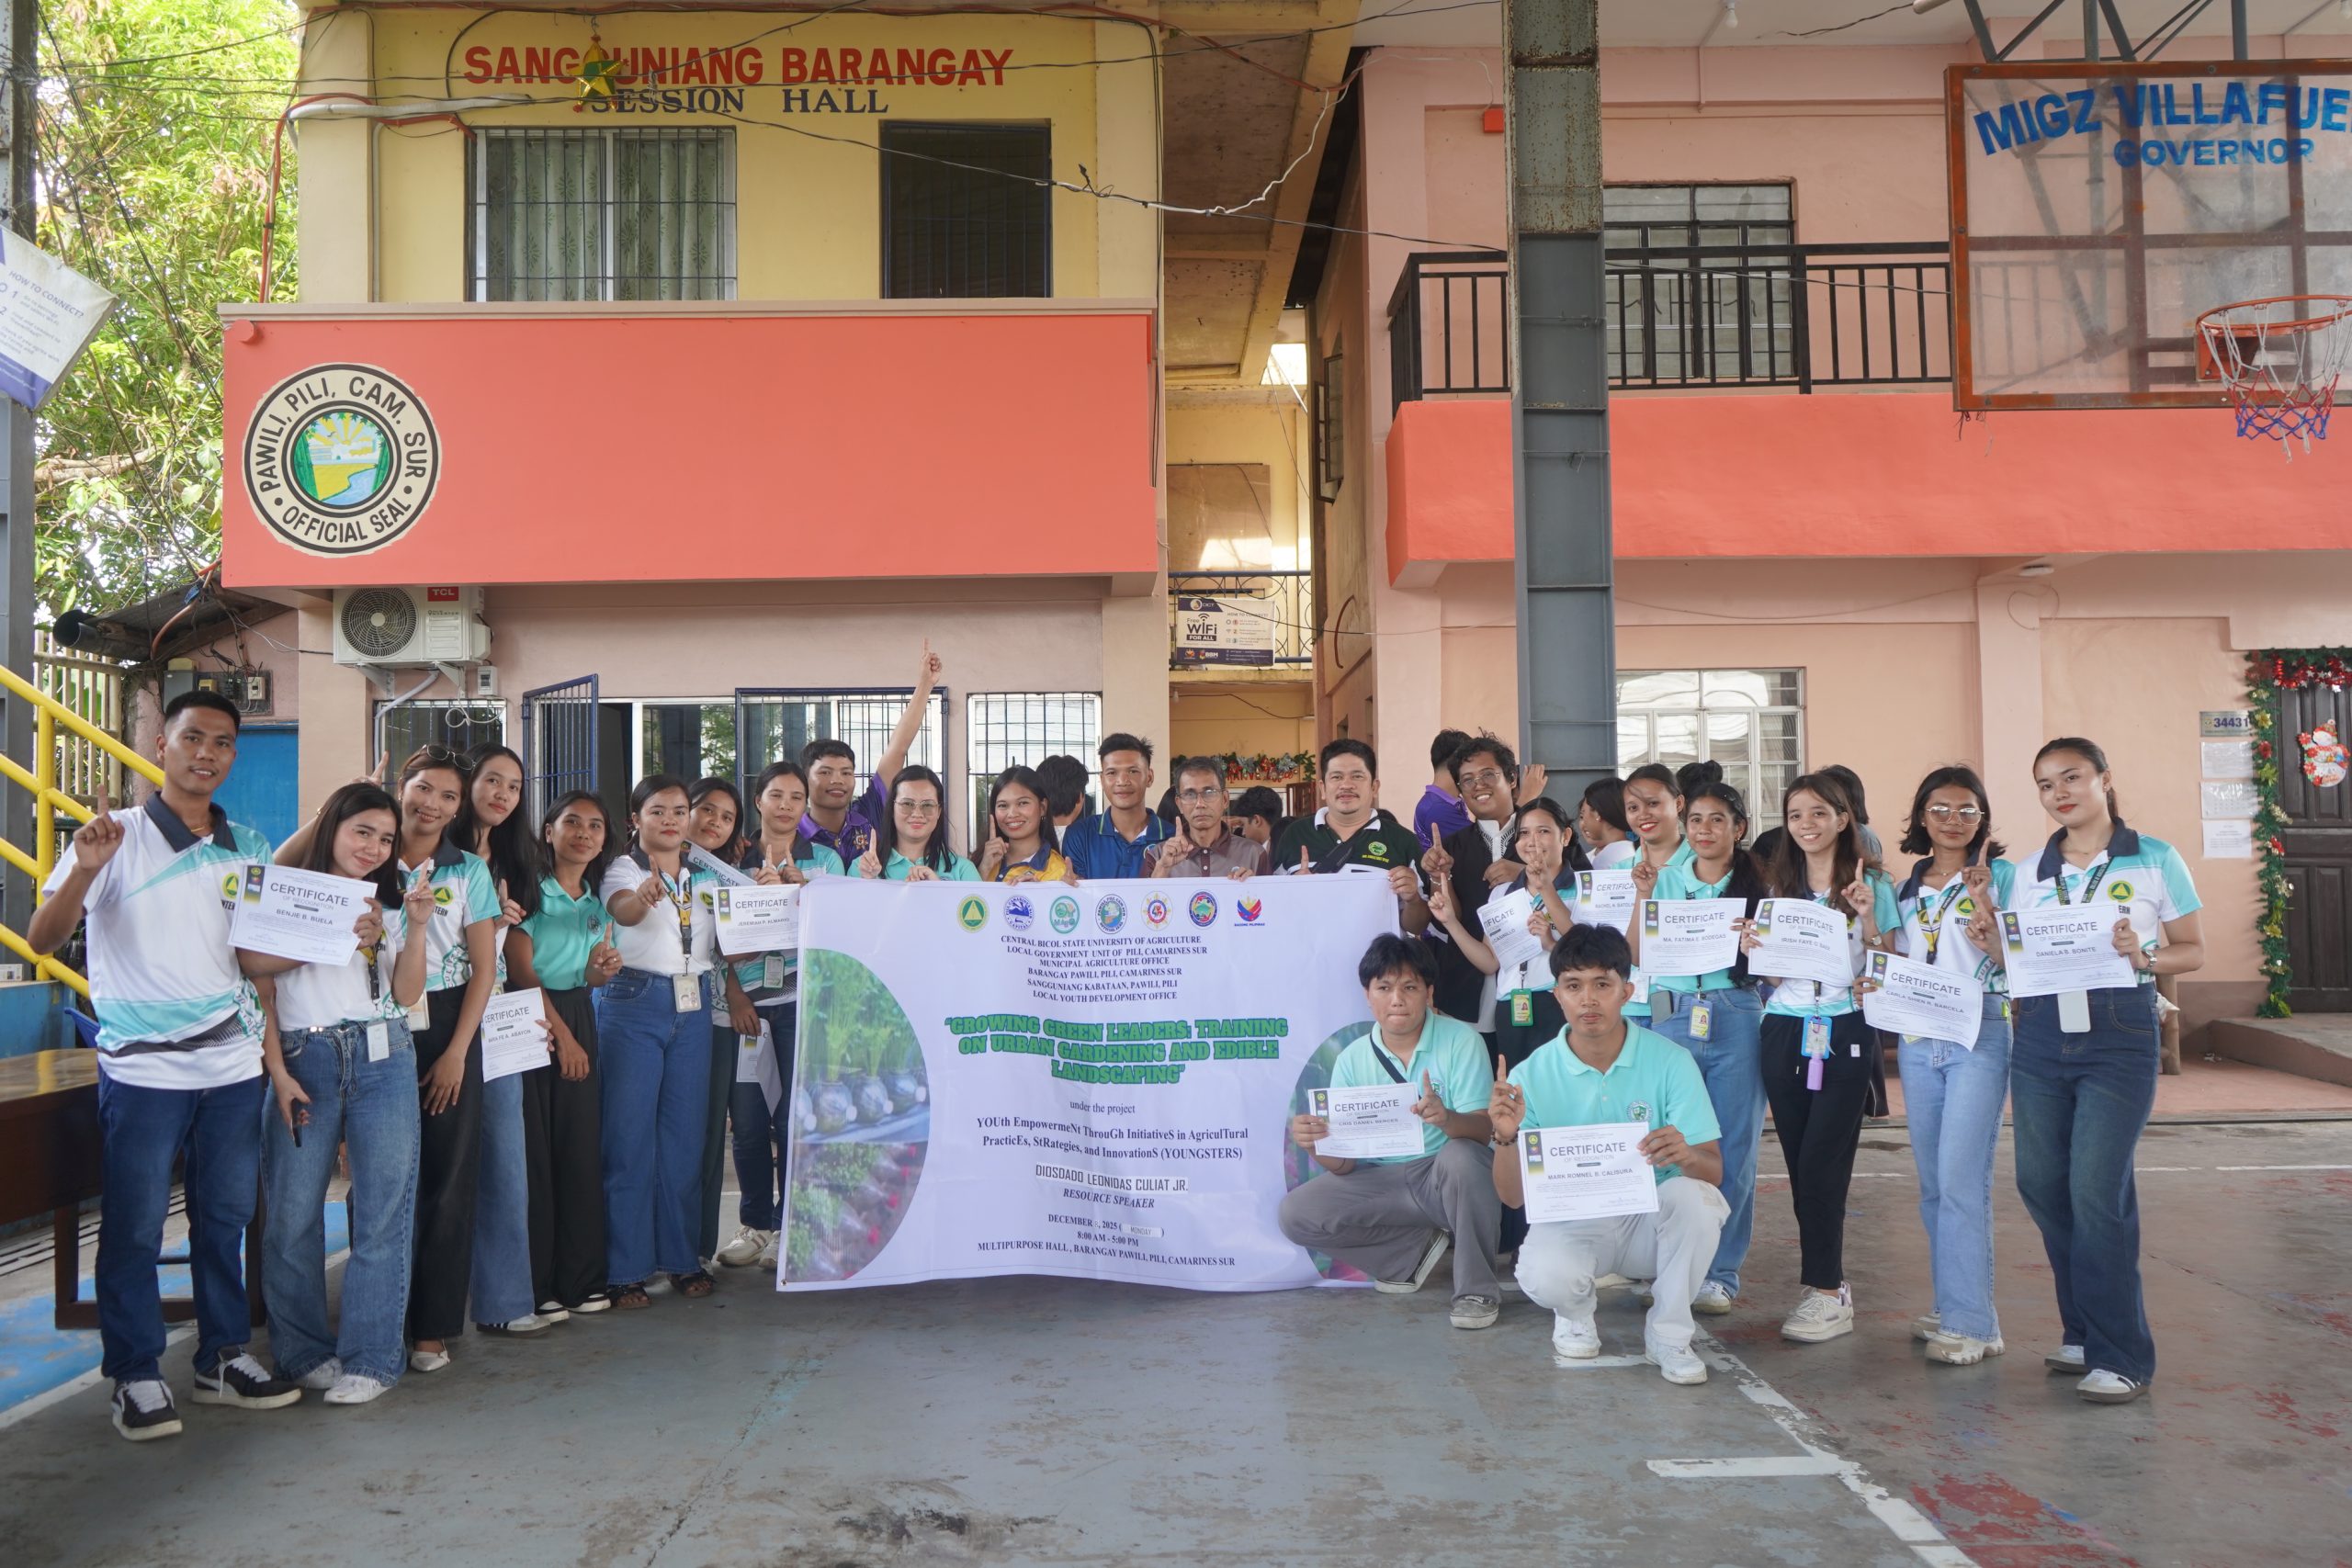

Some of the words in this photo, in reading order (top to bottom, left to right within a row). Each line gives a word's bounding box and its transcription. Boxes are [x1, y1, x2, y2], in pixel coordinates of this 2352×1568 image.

[782, 47, 1013, 85] BARANGAY
[782, 88, 888, 113] HALL
[1973, 87, 2103, 155] MIGZ
[2112, 82, 2352, 132] VILLAFUE
[2113, 138, 2314, 168] GOVERNOR
[9, 270, 29, 288] HOW
[29, 282, 41, 294] TO
[41, 289, 85, 318] CONNECT?
[255, 413, 292, 492] PAWILI,
[284, 378, 335, 412] PILI,
[349, 377, 407, 424] CAM.
[403, 432, 427, 478] SUR
[282, 505, 368, 543] OFFICIAL
[369, 497, 412, 534] SEAL
[432, 588, 455, 596] TCL
[1187, 619, 1217, 634] WiFi
[270, 883, 349, 907] CERTIFICATE
[1597, 883, 1634, 891] CERTIFICA
[735, 899, 788, 909] CERTIFICATE
[2119, 905, 2131, 915] ERN
[277, 908, 300, 918] BENJIE
[311, 916, 333, 925] BUELA
[1665, 912, 1724, 923] CERTIFICATE
[1778, 915, 1834, 933] CERTIFICATE
[1955, 918, 1971, 926] INTE
[2027, 922, 2098, 935] CERTIFICATE
[1001, 935, 1036, 946] CENTRAL
[1088, 937, 1133, 947] UNIVERSITY
[1147, 936, 1201, 944] AGRICULTURE
[1007, 945, 1033, 955] LOCAL
[1035, 950, 1089, 958] GOVERNMENT
[1092, 949, 1110, 957] UNIT
[1145, 947, 1191, 955] CAMARINES
[1193, 946, 1207, 954] SUR
[1040, 959, 1082, 967] MUNICIPAL
[1085, 958, 1139, 967] AGRICULTURE
[1141, 956, 1170, 964] OFFICE
[1028, 967, 1069, 978] BARANGAY
[1119, 968, 1165, 976] CAMARINES
[1028, 978, 1082, 991] SANGGUNIANG
[1084, 982, 1129, 990] KABATAAN,
[1891, 973, 1962, 996] CERTIFICATE
[1034, 990, 1058, 1000] LOCAL
[1089, 993, 1147, 1002] DEVELOPMENT
[1043, 1019, 1103, 1042] GREEN
[1106, 1020, 1192, 1041] LEADERS:
[1194, 1018, 1289, 1039] TRAINING
[958, 1035, 988, 1055] ON
[989, 1034, 1055, 1056] URBAN
[1057, 1042, 1166, 1063] GARDENING
[1169, 1041, 1210, 1062] AND
[1213, 1040, 1280, 1060] EDIBLE
[1051, 1059, 1185, 1084] LANDSCAPING"
[1069, 1101, 1091, 1111] under
[1092, 1103, 1104, 1112] the
[1107, 1103, 1135, 1115] project
[1335, 1100, 1399, 1111] CERTIFICATE
[977, 1116, 1010, 1128] YOUth
[1013, 1117, 1080, 1134] EmpowermeNt
[1083, 1125, 1124, 1139] ThrouGh
[1127, 1128, 1174, 1140] InitiativeS
[1177, 1130, 1185, 1140] in
[1189, 1128, 1248, 1143] AgriculTural
[983, 1134, 1031, 1147] PracticEs,
[1034, 1136, 1082, 1154] StRategies,
[1084, 1146, 1100, 1156] and
[1102, 1146, 1159, 1158] InnovationS
[1160, 1147, 1242, 1160] (YOUNGSTERS)
[1550, 1143, 1626, 1156] CERTIFICATE
[1035, 1164, 1083, 1183] DIOSDADO
[1088, 1173, 1132, 1190] LEONIDAS
[1136, 1179, 1170, 1191] CULIAT
[1173, 1179, 1188, 1191] JR.
[1602, 1168, 1633, 1177] CALISURA
[1063, 1189, 1112, 1204] RESOURCE
[1113, 1195, 1155, 1208] SPEAKER
[1048, 1213, 1093, 1227] DECEMBER
[1102, 1221, 1117, 1230] 2025
[1130, 1226, 1151, 1235] MONDAY
[1077, 1231, 1091, 1241] 8:00
[1093, 1234, 1105, 1242] AM
[1112, 1235, 1125, 1245] 5:00
[1127, 1237, 1138, 1247] PM
[978, 1240, 1043, 1251] MULTIPURPOSE
[1074, 1245, 1117, 1257] BARANGAY
[1168, 1257, 1217, 1266] CAMARINES
[1219, 1257, 1235, 1266] SUR
